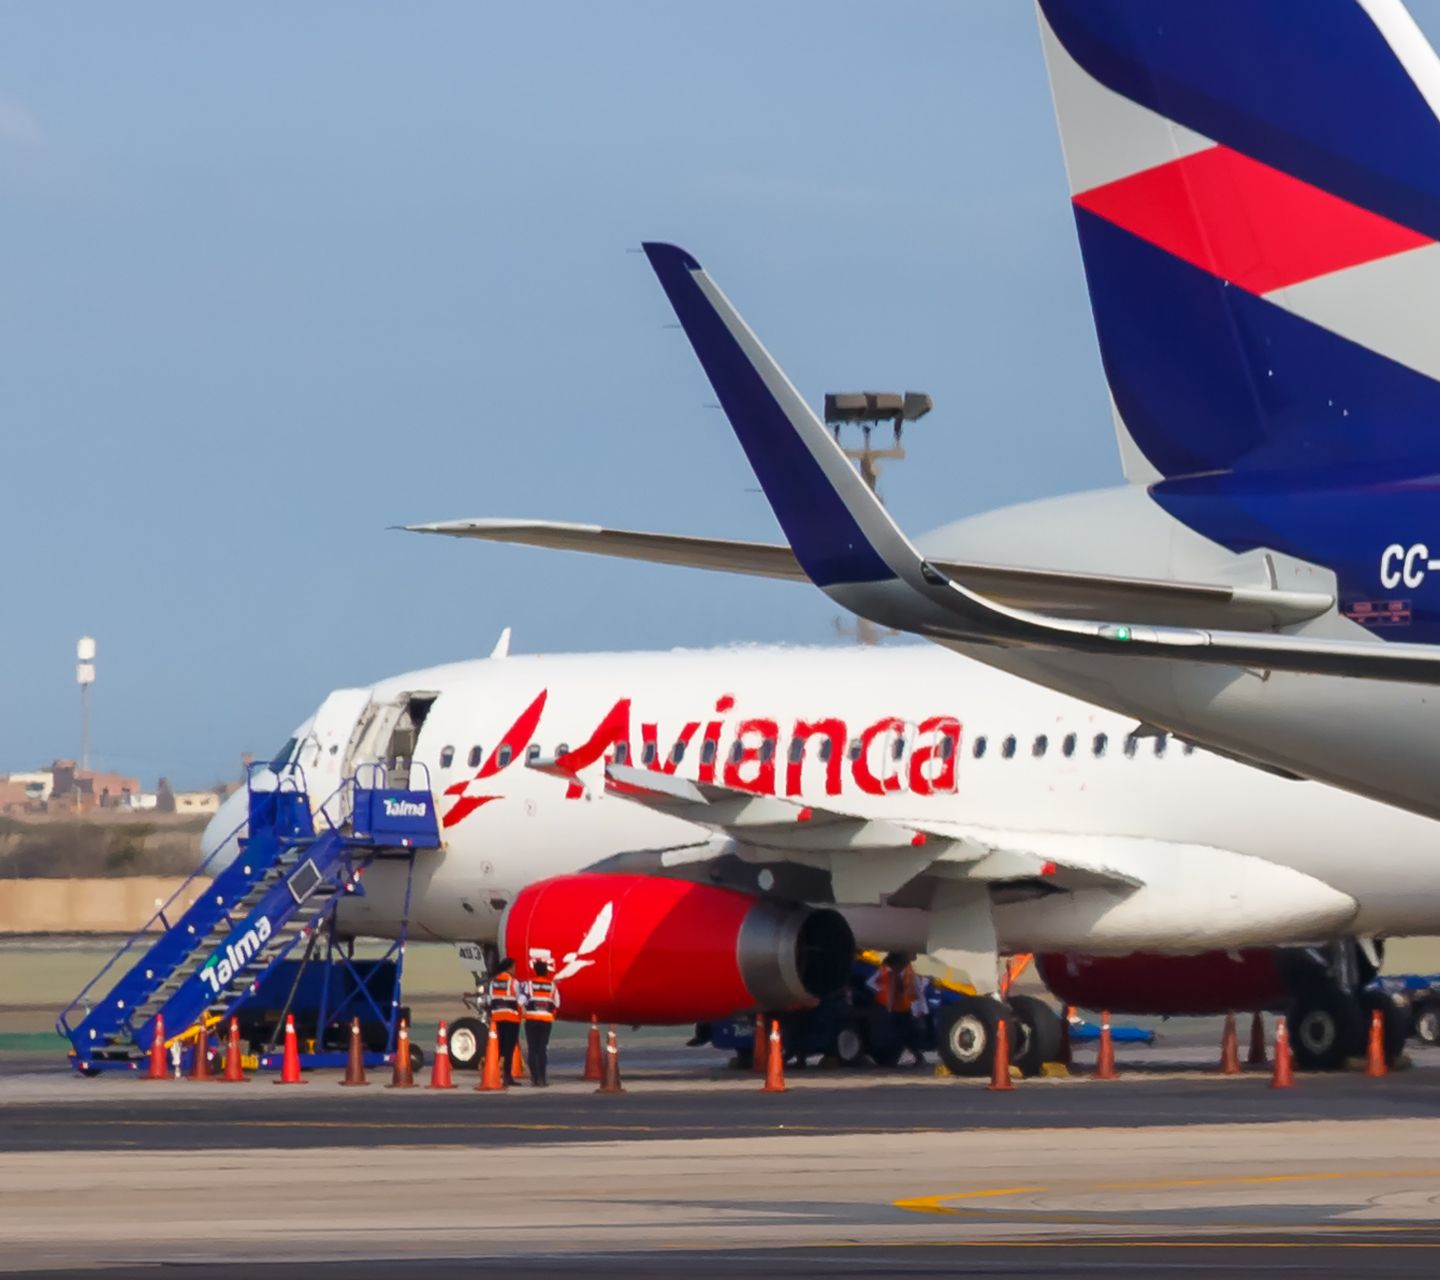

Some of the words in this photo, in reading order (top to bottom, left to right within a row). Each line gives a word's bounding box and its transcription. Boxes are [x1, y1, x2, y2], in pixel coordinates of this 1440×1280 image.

[556, 693, 962, 800] Avianca
[383, 798, 426, 817] Talma
[201, 915, 271, 992] Talma
